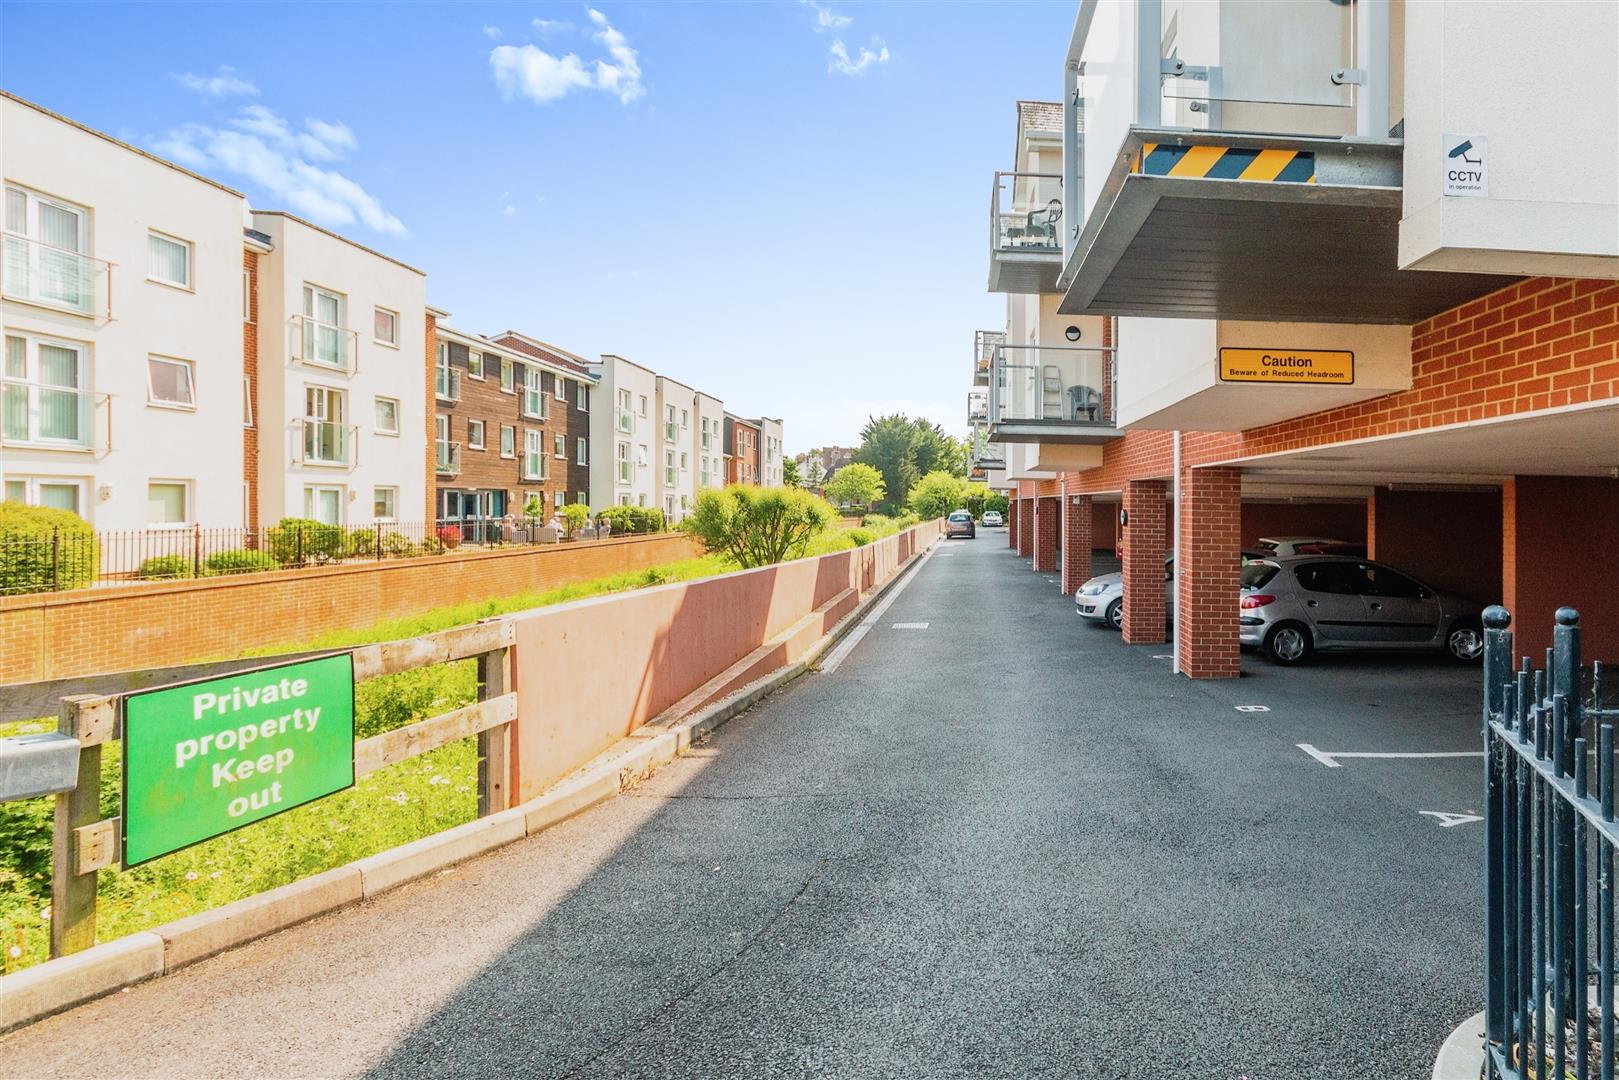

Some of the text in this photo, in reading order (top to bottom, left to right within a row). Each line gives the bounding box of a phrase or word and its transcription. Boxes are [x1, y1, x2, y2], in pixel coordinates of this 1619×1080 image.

[1448, 170, 1482, 182] CCTV
[1261, 355, 1313, 368] Caution
[1307, 370, 1345, 378] Headroom
[193, 678, 308, 720] Private
[175, 706, 321, 768] property
[212, 747, 294, 788] Keep
[227, 781, 283, 818] out
